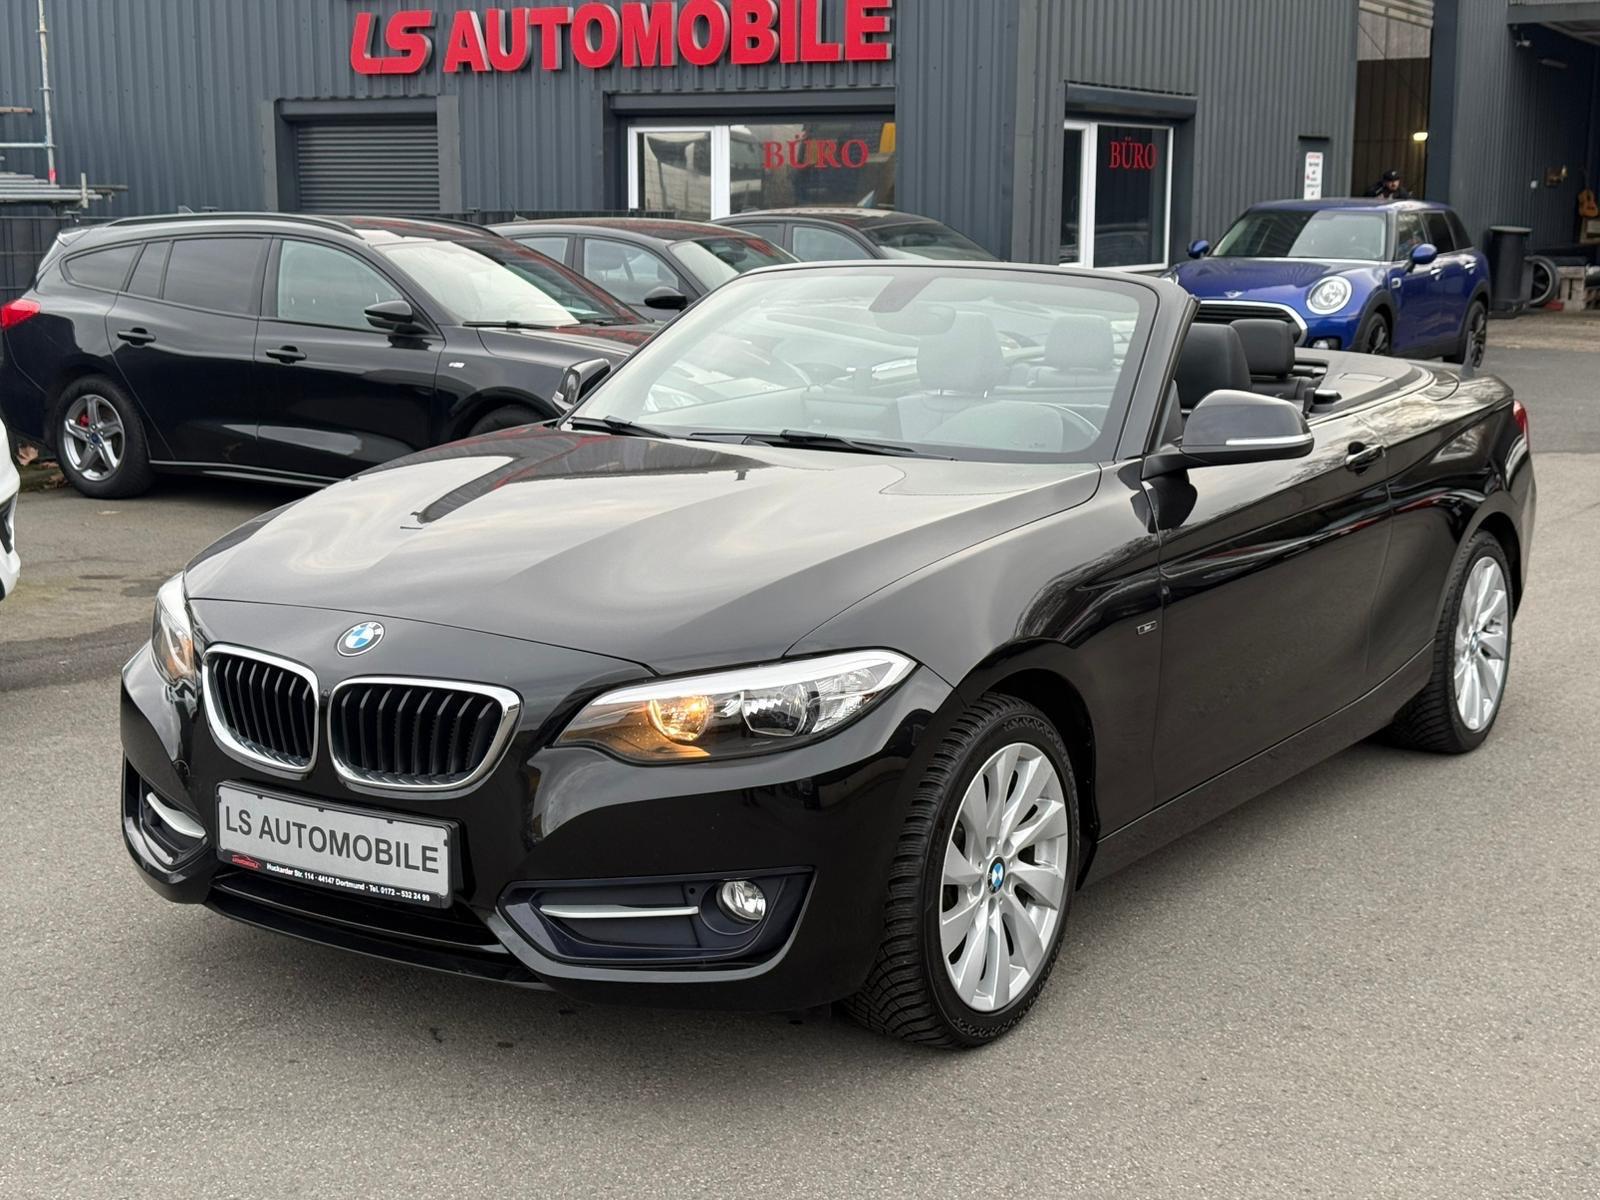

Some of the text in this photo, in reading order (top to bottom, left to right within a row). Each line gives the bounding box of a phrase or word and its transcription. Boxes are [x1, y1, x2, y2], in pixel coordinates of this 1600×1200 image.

[350, 0, 893, 75] LS AUTOMOBILE
[762, 131, 869, 170] BÜRO
[1109, 136, 1157, 170] BÜRO
[226, 806, 439, 874] LS AUTOMOBILE
[266, 862, 294, 876] Huckarder
[304, 871, 315, 881] 114
[318, 874, 335, 885] 44147
[335, 878, 365, 891] Dortmund
[369, 884, 380, 893] Tel.
[380, 886, 396, 896] 0172
[413, 892, 421, 900] 24
